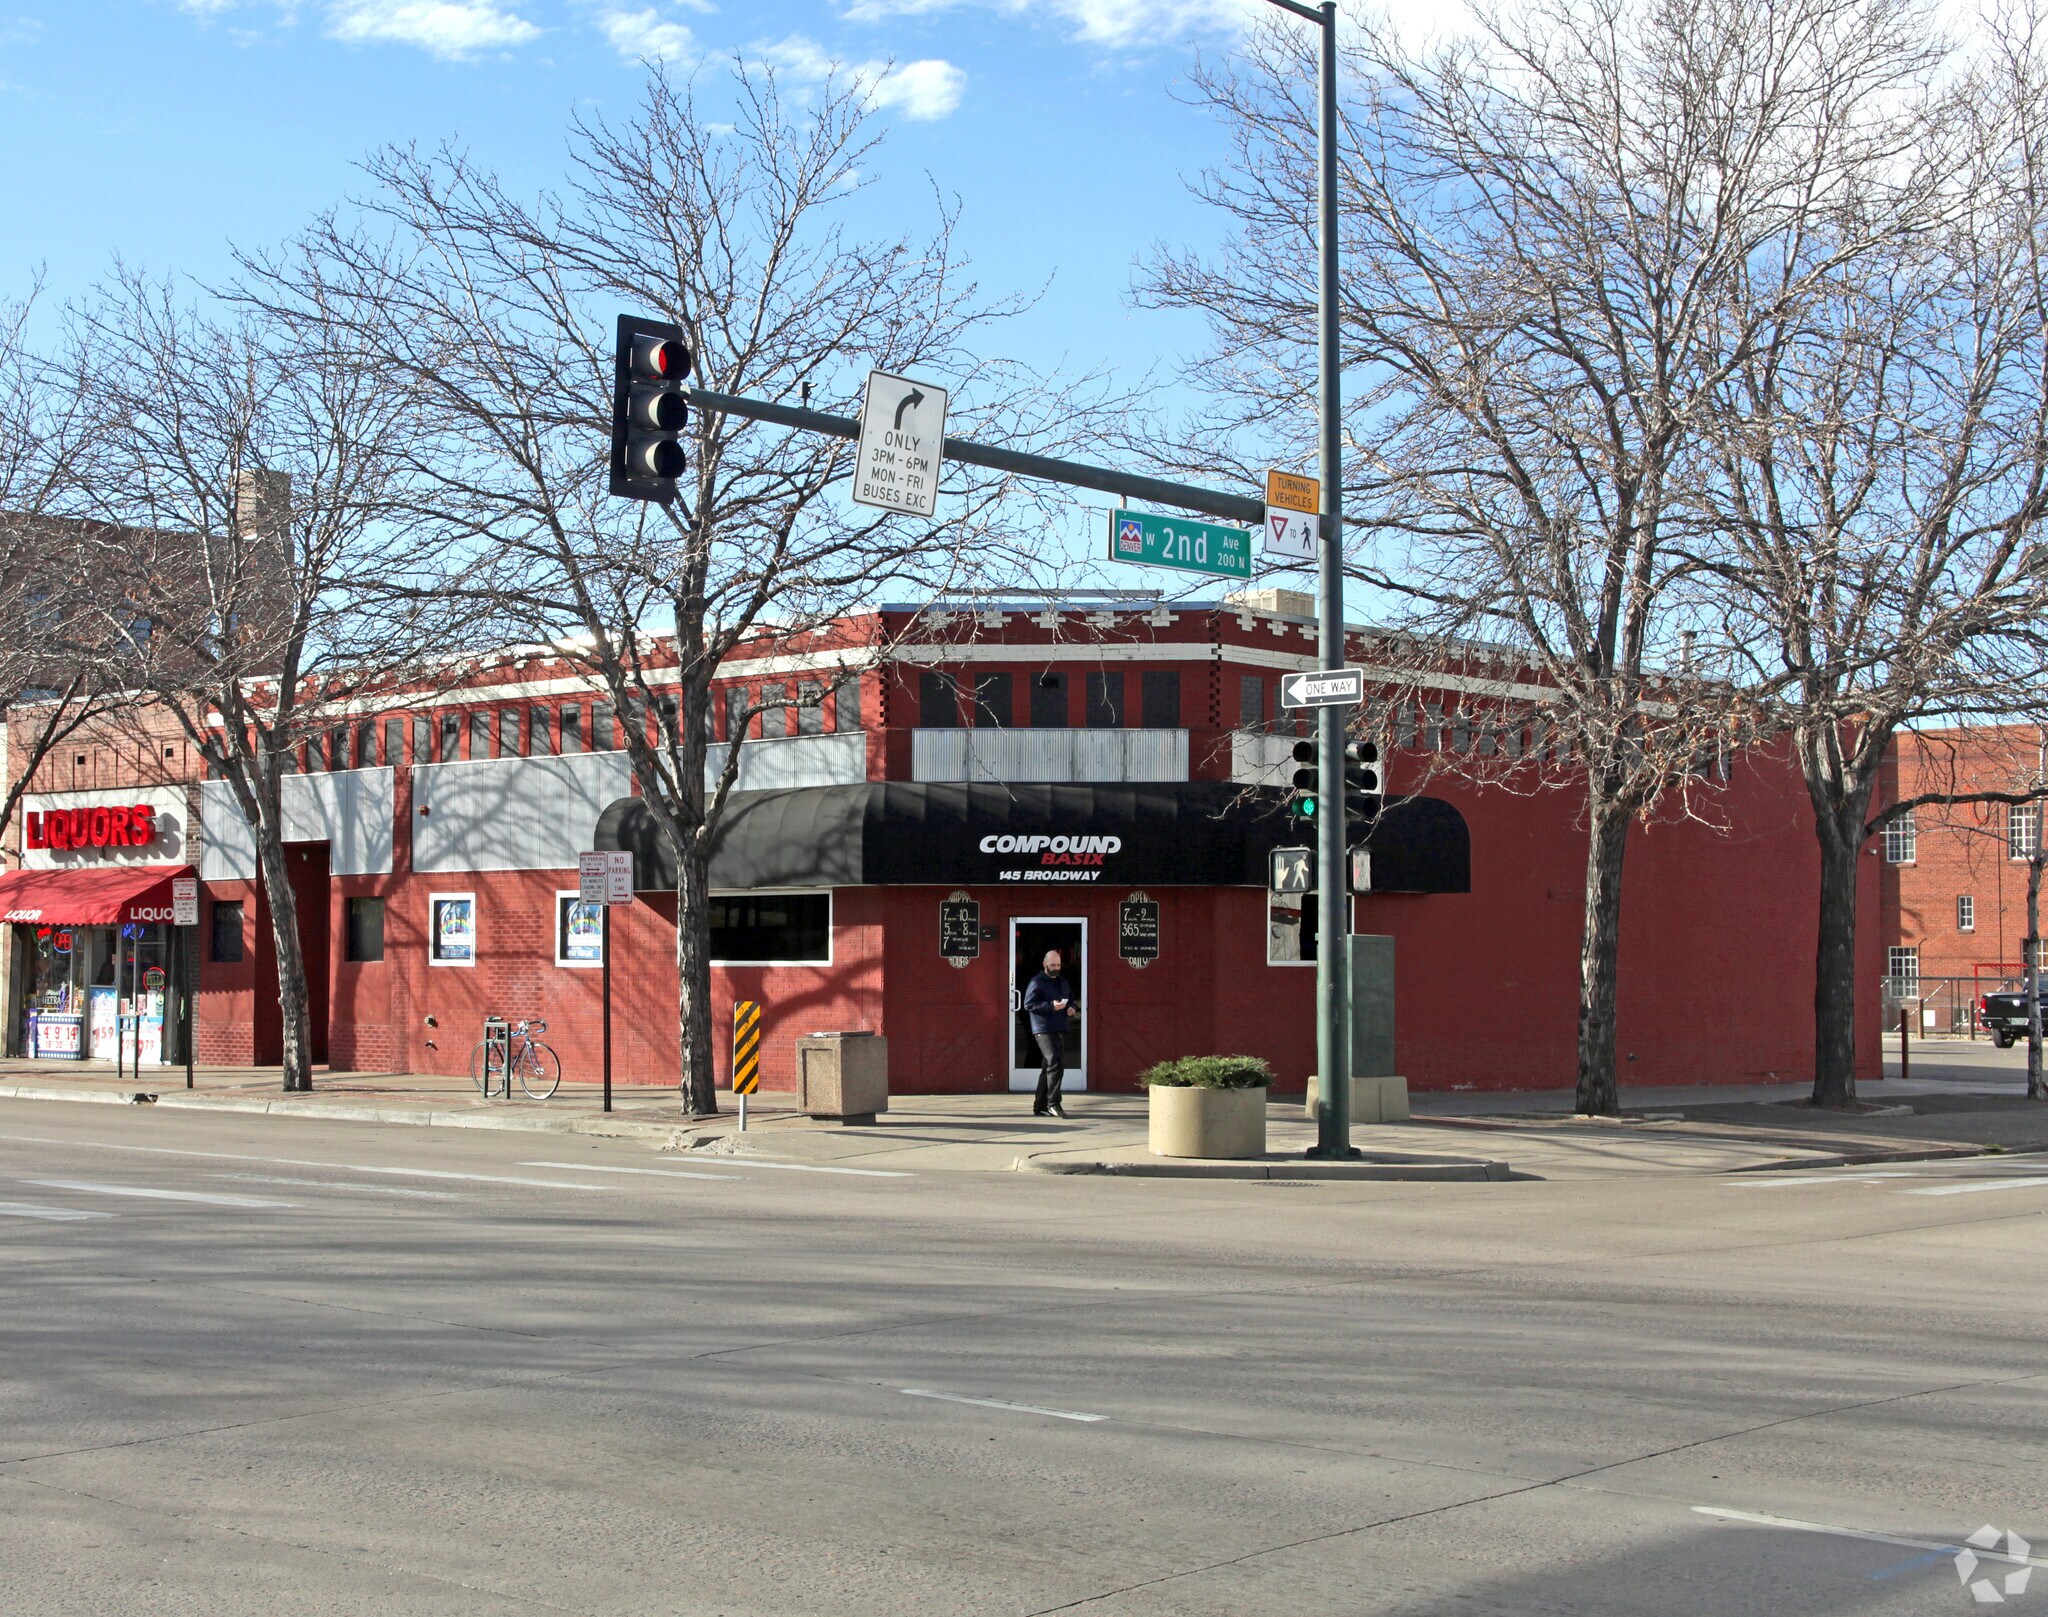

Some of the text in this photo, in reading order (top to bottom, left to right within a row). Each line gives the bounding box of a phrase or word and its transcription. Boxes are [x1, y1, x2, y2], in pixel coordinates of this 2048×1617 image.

[885, 431, 921, 452] ONLY
[872, 448, 895, 465] 3PM
[906, 457, 929, 473] 6PM
[871, 466, 896, 483] MON
[906, 474, 924, 490] FRI
[1277, 477, 1311, 494] TURNING
[863, 483, 927, 509] BUSES EXC
[1275, 491, 1312, 509] VEHICLES
[1290, 528, 1296, 539] TO
[1120, 540, 1141, 552] DENVER
[1146, 527, 1239, 564] W 2nd Ave
[1217, 553, 1245, 569] 200 N
[1306, 680, 1353, 695] ONE WAY
[27, 804, 156, 851] LIQUORS
[979, 835, 1122, 854] COMPOUND
[615, 856, 625, 864] NO
[1041, 853, 1104, 865] BASIX
[608, 866, 630, 874] PARKING
[1000, 870, 1101, 881] 145 BROADWAY
[1130, 892, 1148, 903] OPEN
[4, 909, 42, 921] LIQUOR
[130, 907, 174, 921] LIQUO
[1122, 922, 1140, 936] 365
[1129, 957, 1148, 968] DAILY
